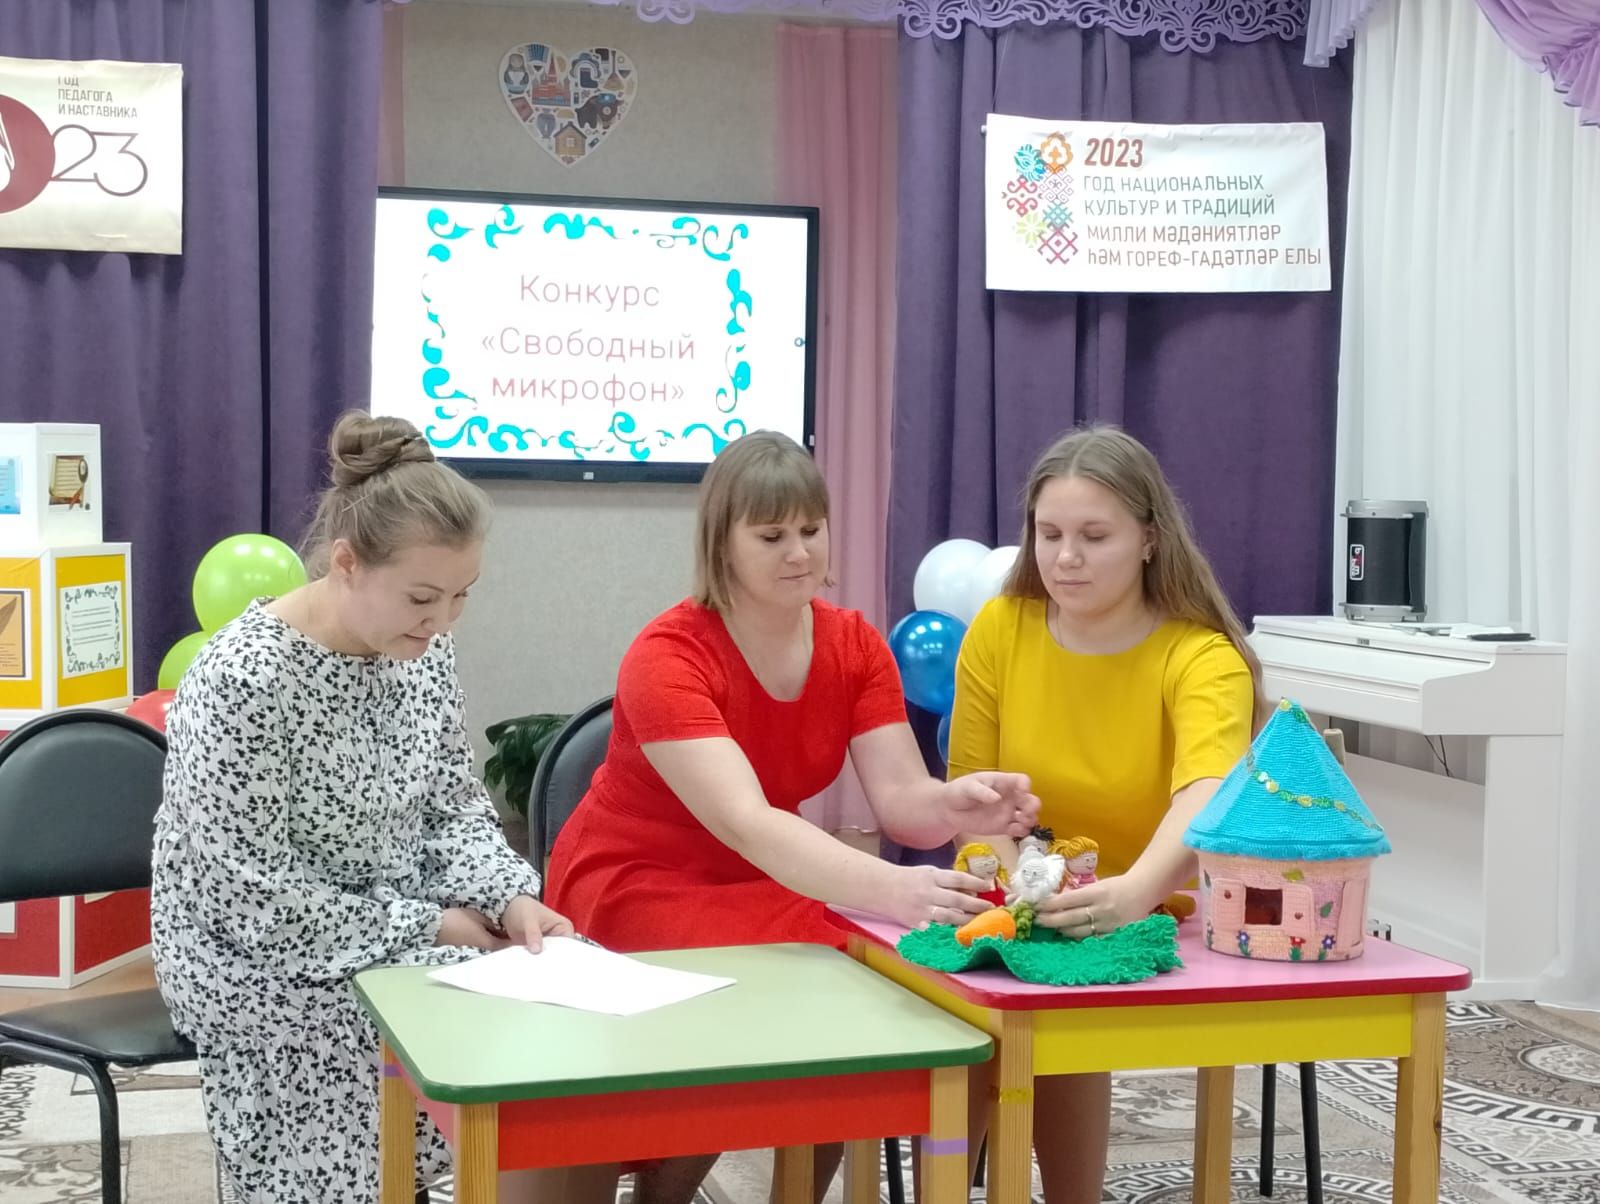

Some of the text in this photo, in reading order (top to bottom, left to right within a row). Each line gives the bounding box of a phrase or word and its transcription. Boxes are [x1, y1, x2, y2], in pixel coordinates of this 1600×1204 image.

[57, 88, 113, 103] ПЕДАГОГА
[58, 103, 138, 118] И НАСТАВНИКА
[1084, 137, 1144, 168] 2023
[1083, 174, 1265, 194] ГОД НАЦИОНАЛЬНЫХ
[1084, 193, 1275, 218] КУЛЬТУР И ТРАДИЦИЙ
[1087, 224, 1281, 246] МИЛЛИ МӘДӘНИЯТЛӘР
[1284, 247, 1322, 265] ЕЛЫ
[519, 274, 661, 312] Конкурс
[481, 326, 696, 363] «Свободный
[491, 373, 686, 408] микрофон»
